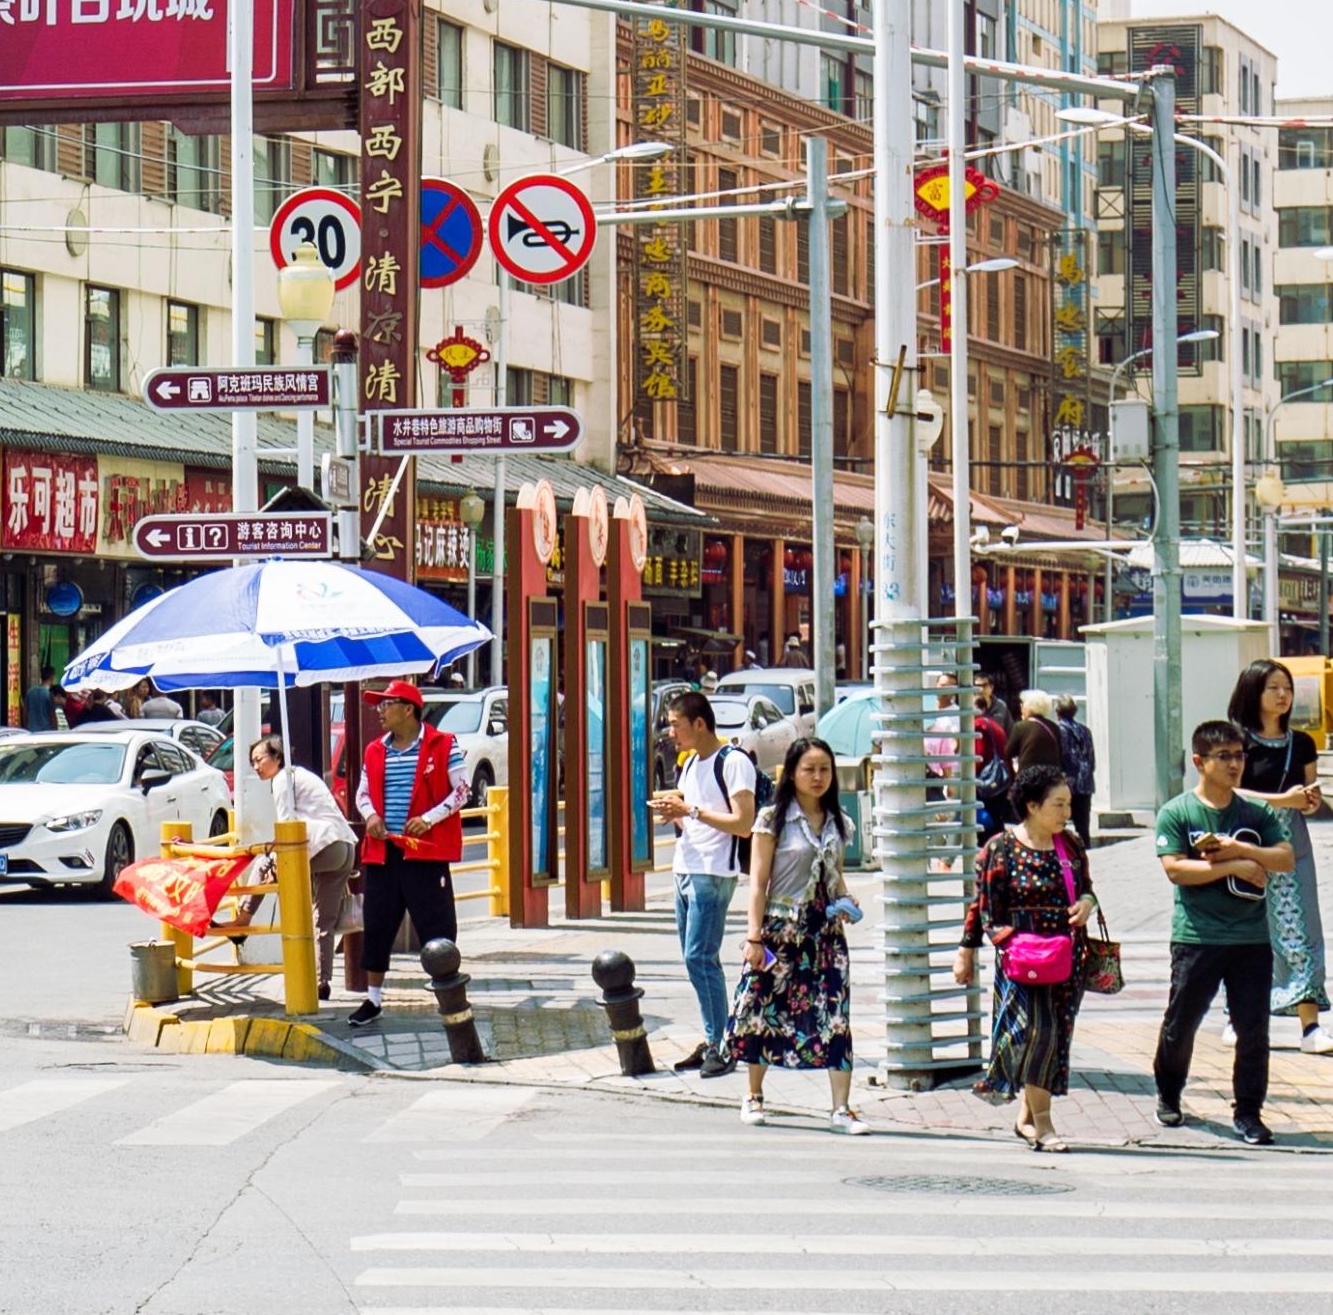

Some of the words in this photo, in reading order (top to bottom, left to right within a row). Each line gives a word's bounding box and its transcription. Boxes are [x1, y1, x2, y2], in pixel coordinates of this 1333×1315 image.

[290, 215, 346, 270] 30
[217, 374, 319, 393] 阿克班玛民族风情宫
[393, 416, 502, 436] 水井巷特色旅游商品购物街
[394, 437, 412, 446] Special
[413, 437, 430, 445] Tourist
[463, 436, 485, 446] Shopping
[486, 436, 502, 445] Street
[8, 464, 97, 539] 乐可超市
[237, 521, 322, 540] 游客咨询中心
[238, 542, 260, 550] Tourist
[261, 541, 298, 550] Information
[299, 540, 321, 549] Center
